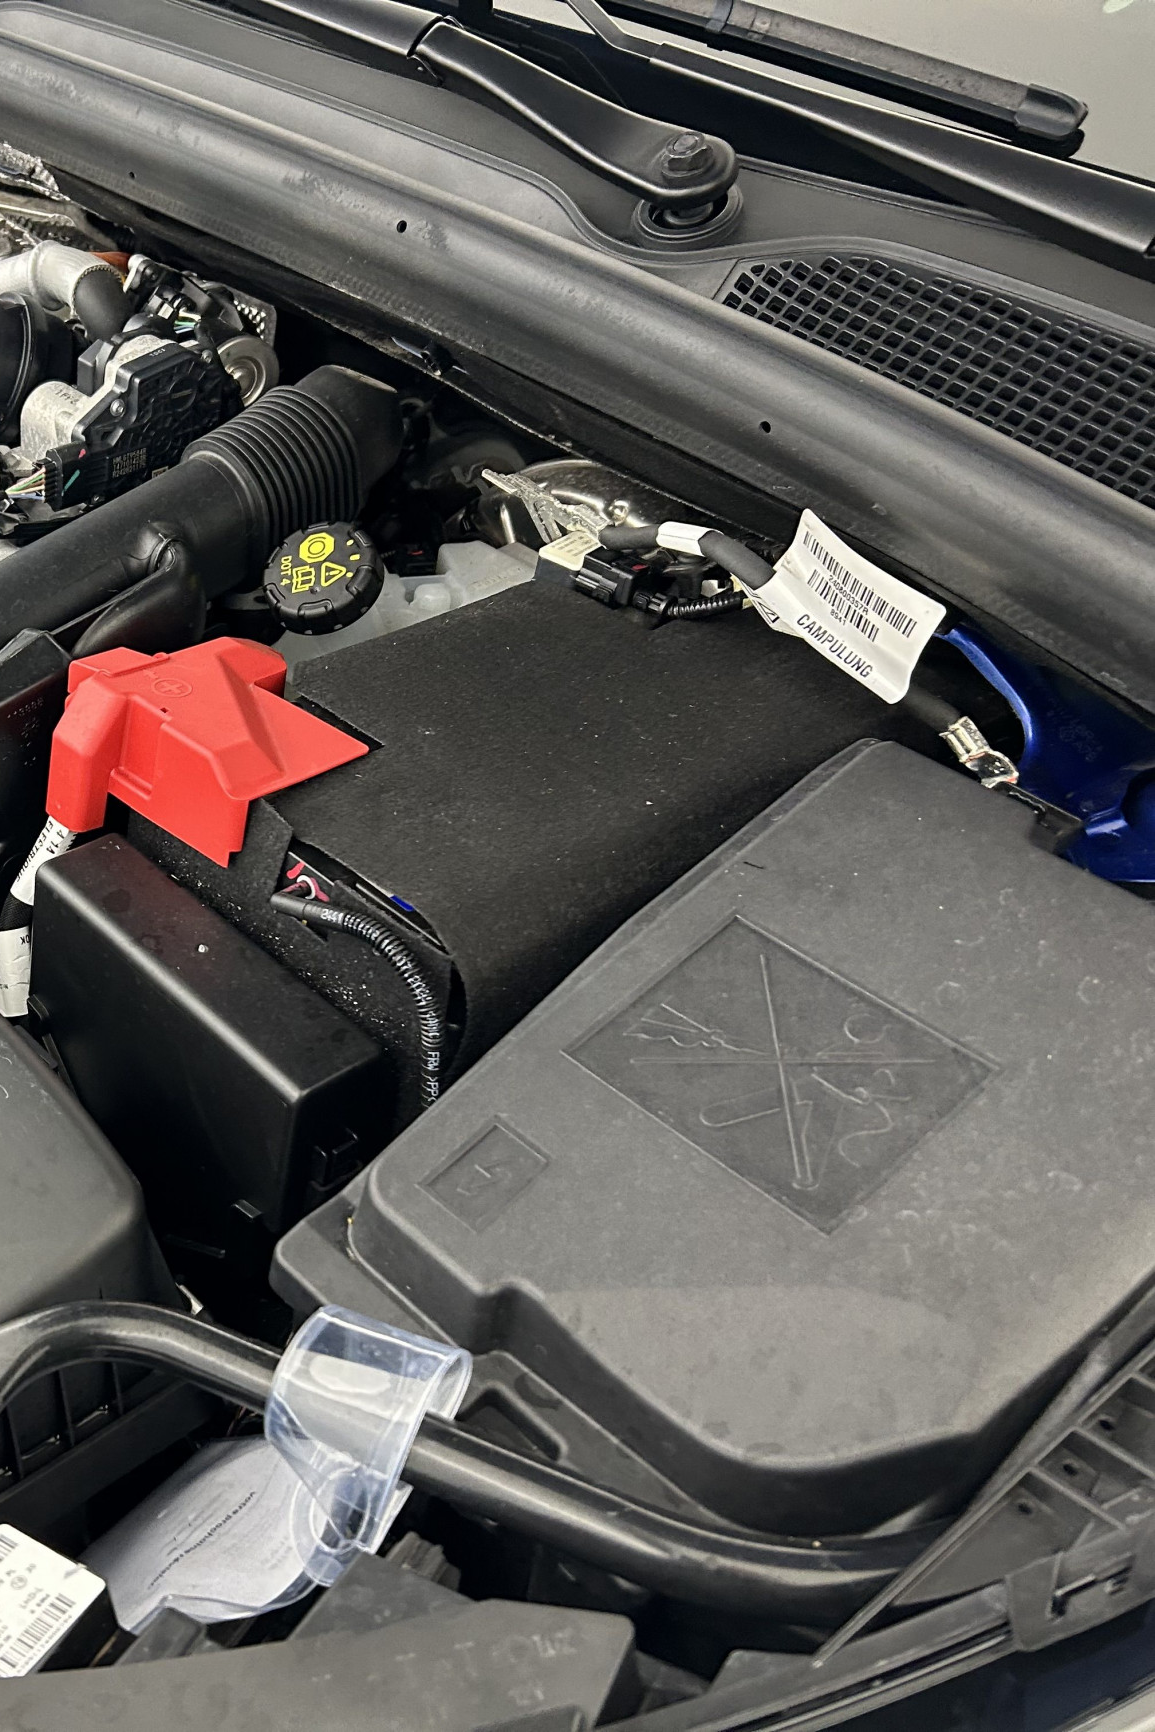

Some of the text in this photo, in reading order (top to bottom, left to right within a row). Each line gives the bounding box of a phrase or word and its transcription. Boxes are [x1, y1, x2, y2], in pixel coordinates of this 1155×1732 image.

[280, 555, 292, 587] DOT 4
[830, 609, 847, 626] 8941
[797, 613, 873, 678] CAMPULUNG
[426, 1049, 439, 1073] FRW
